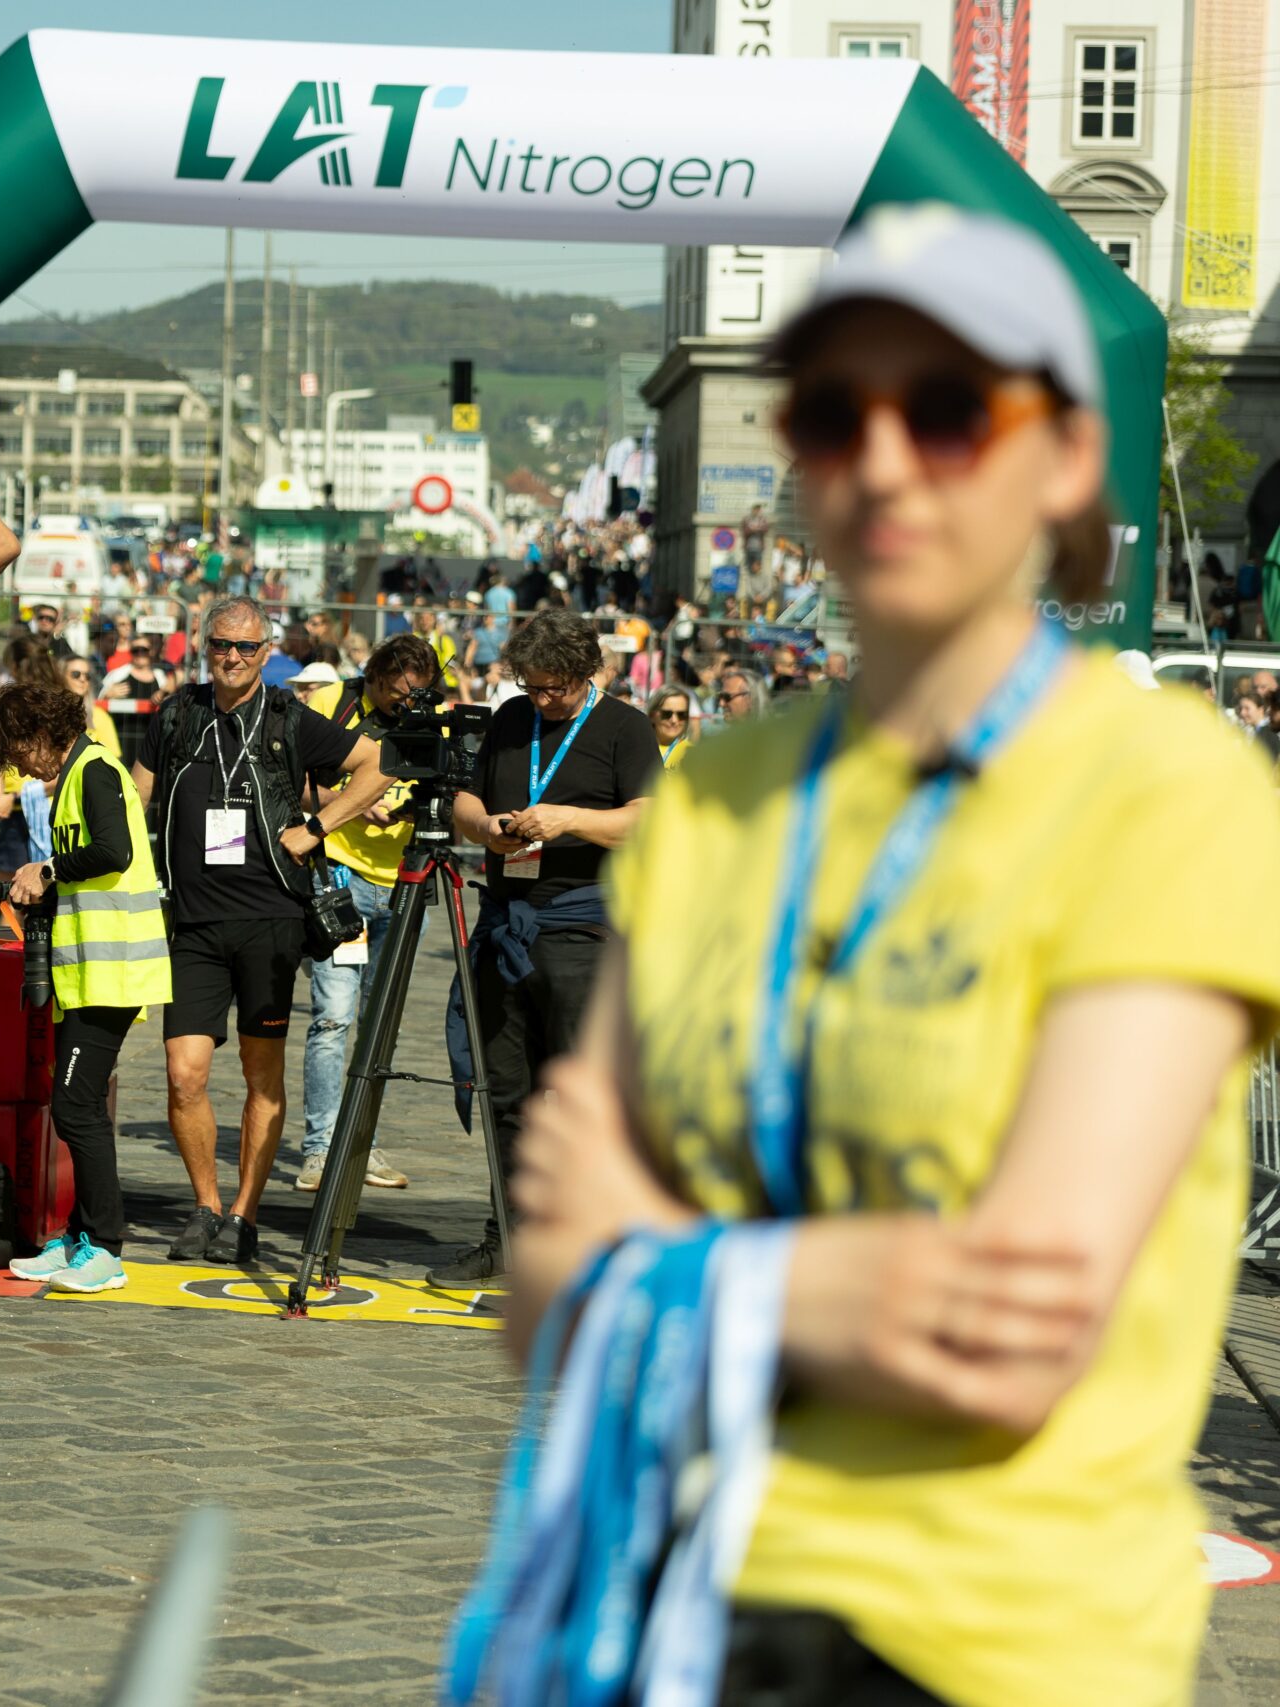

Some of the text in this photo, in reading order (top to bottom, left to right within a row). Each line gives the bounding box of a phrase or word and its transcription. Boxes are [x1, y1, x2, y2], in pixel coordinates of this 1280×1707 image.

[175, 76, 756, 210] LAT Nitrogen
[64, 1055, 77, 1087] MARTINI
